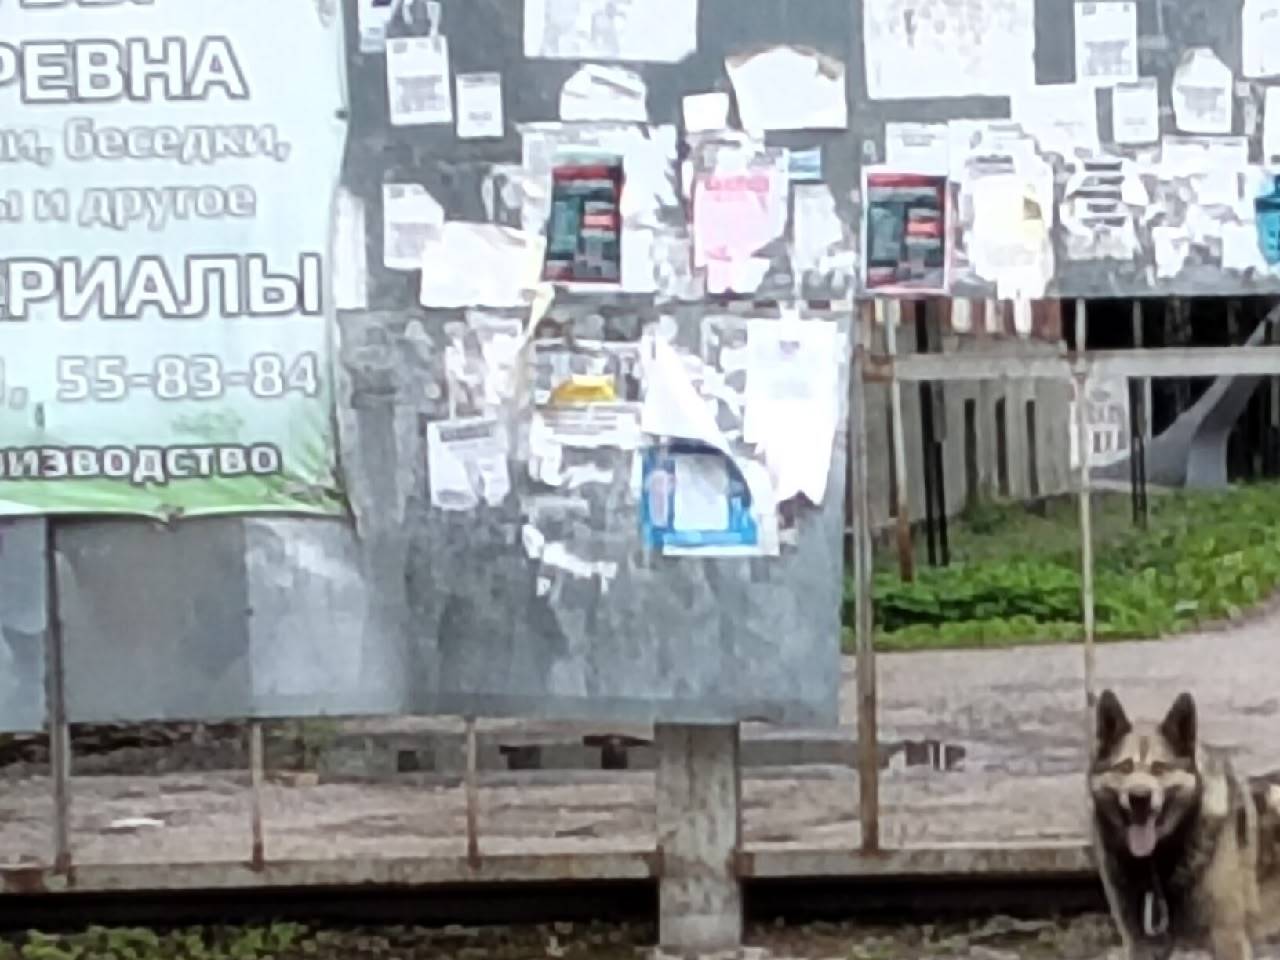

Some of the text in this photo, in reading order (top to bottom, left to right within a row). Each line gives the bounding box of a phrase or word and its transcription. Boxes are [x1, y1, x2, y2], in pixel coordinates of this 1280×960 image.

[63, 116, 292, 165] беседки,
[33, 187, 69, 222] и
[77, 184, 257, 231] другое
[0, 252, 323, 320] РИАЛЫ
[56, 351, 320, 401] 55-83-84
[0, 442, 283, 484] ИЗВОДСТВО
